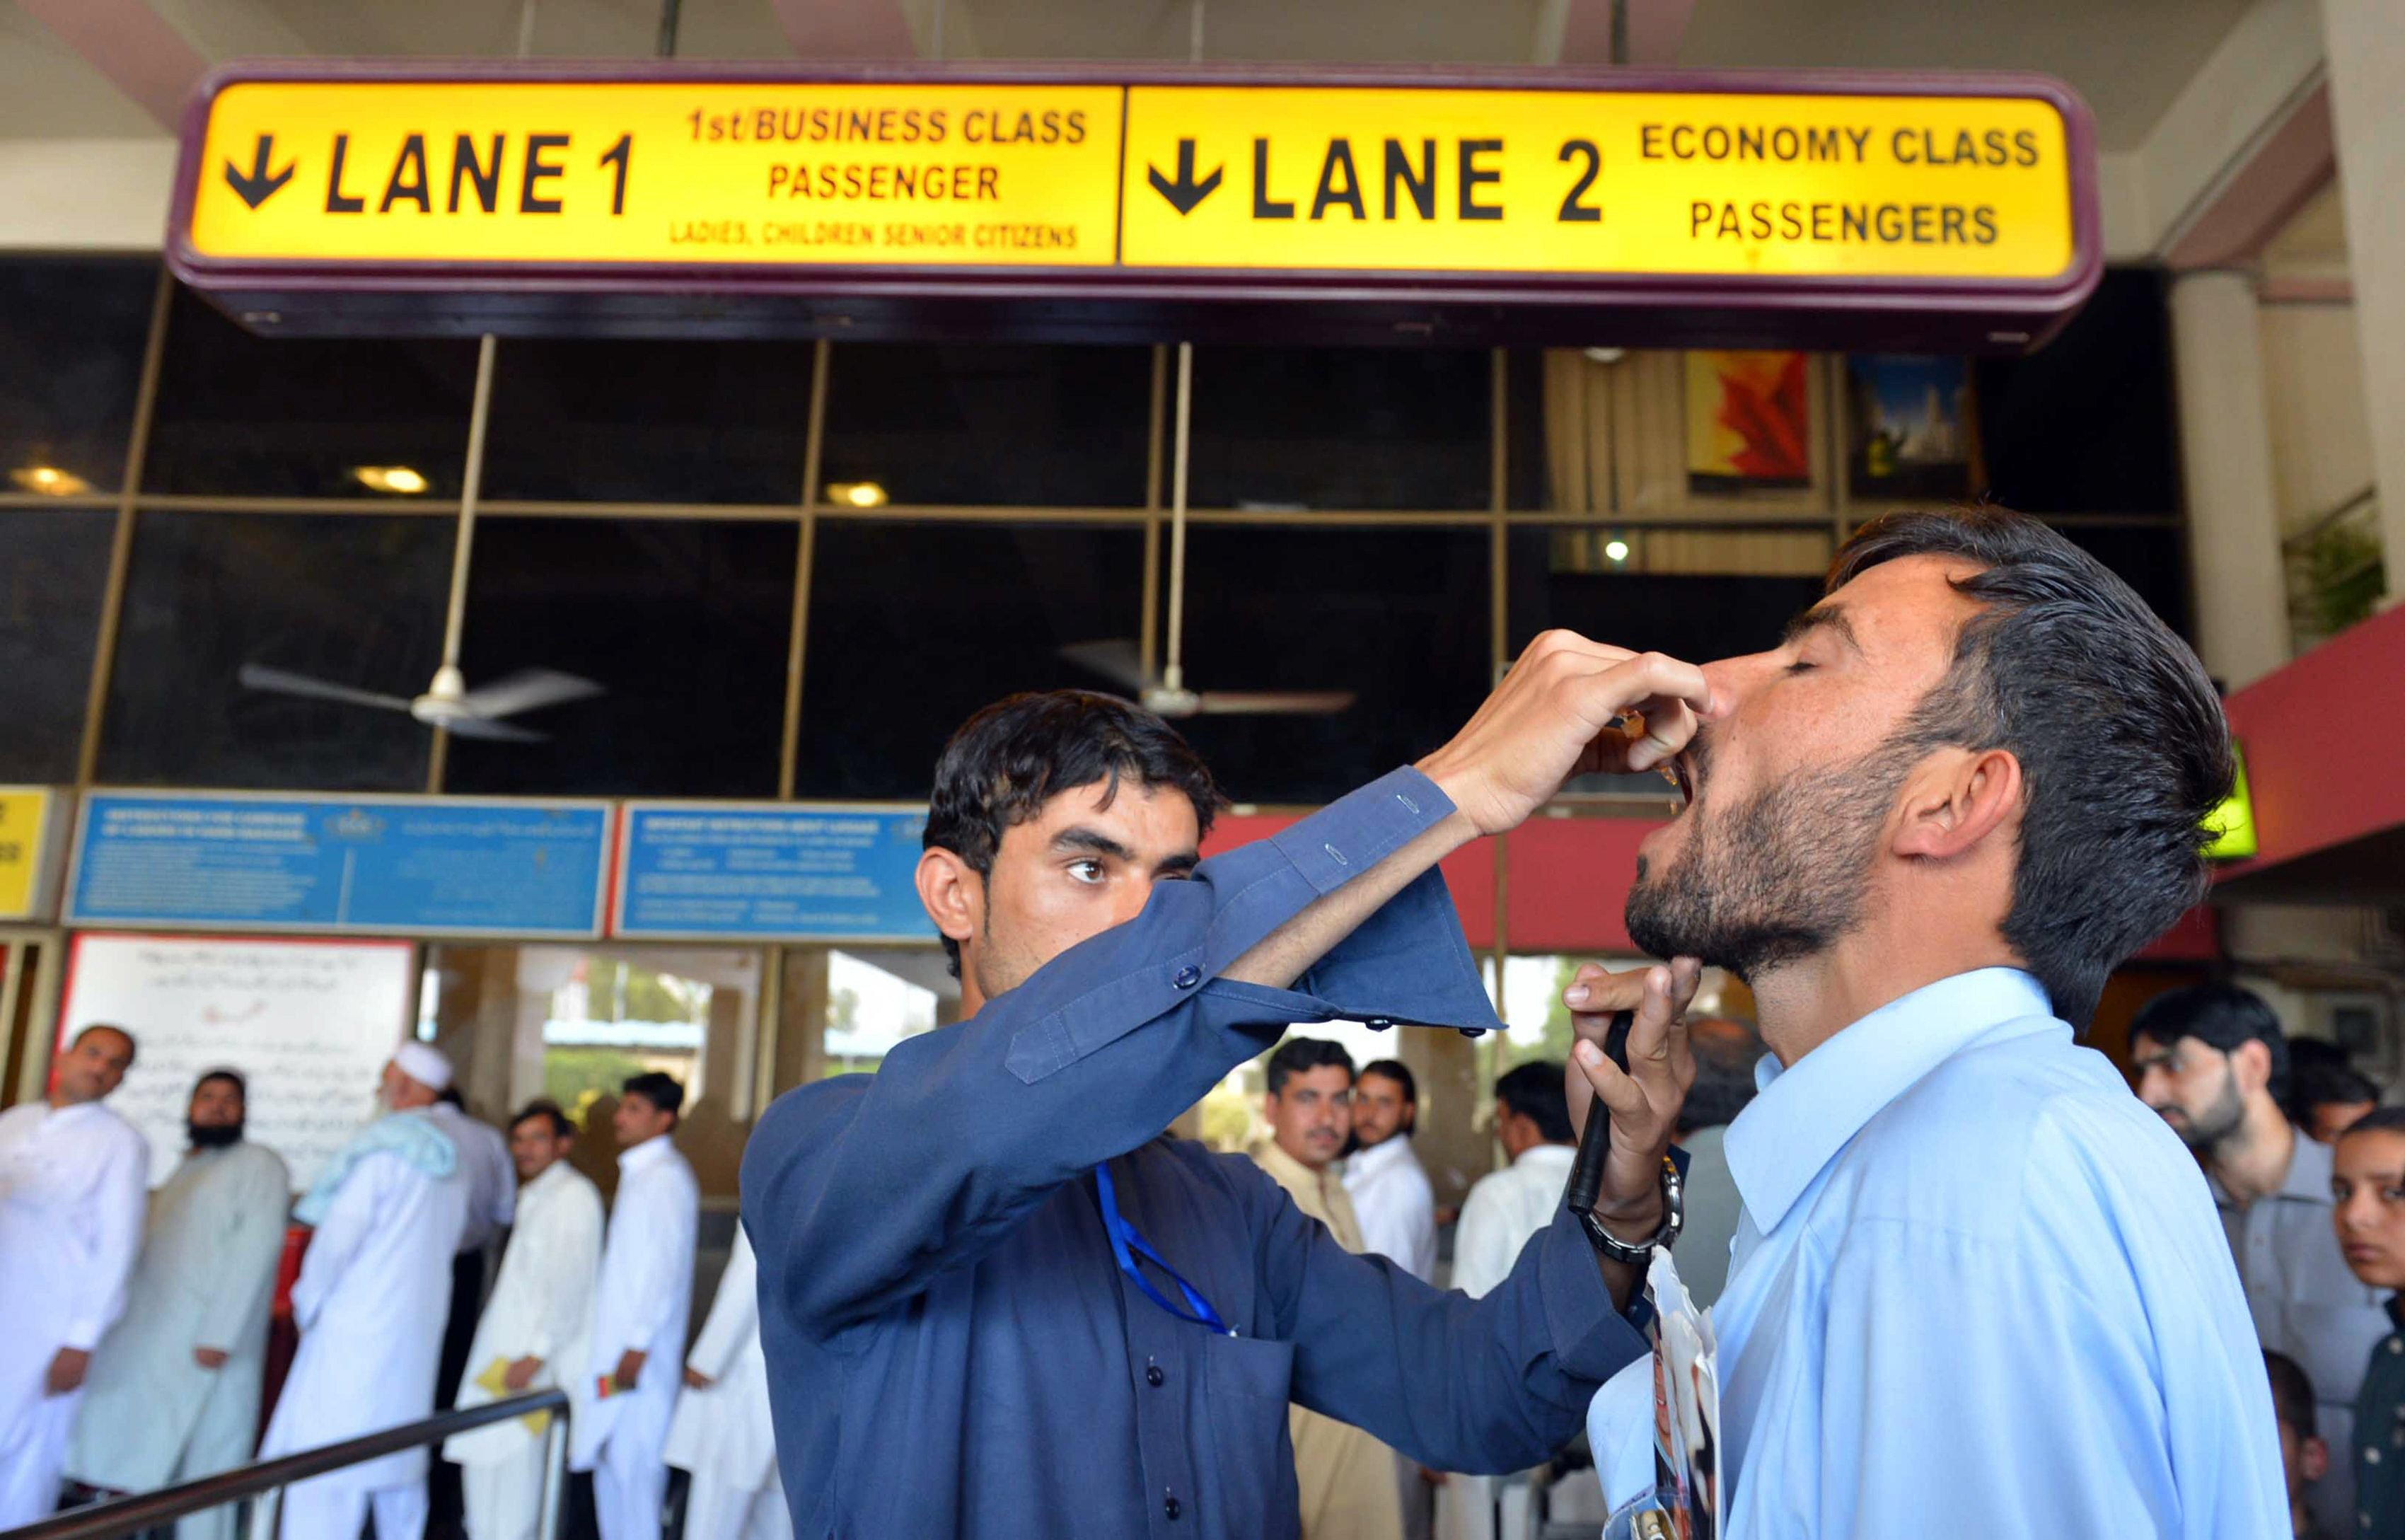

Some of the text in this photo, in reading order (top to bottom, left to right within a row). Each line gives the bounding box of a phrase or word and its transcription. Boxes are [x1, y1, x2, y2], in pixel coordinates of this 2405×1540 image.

[961, 109, 1087, 146] CLASS
[1639, 122, 2040, 170] ECONOMY CLASS
[323, 131, 635, 217] LANE 1
[767, 163, 1001, 202] PASSENGER
[1251, 136, 1604, 223] LANE 2
[762, 220, 876, 250] CHILDREN
[883, 221, 968, 251] SENIOR
[972, 221, 1079, 251] CITIZENS
[1689, 200, 2000, 247] PASSENGERS
